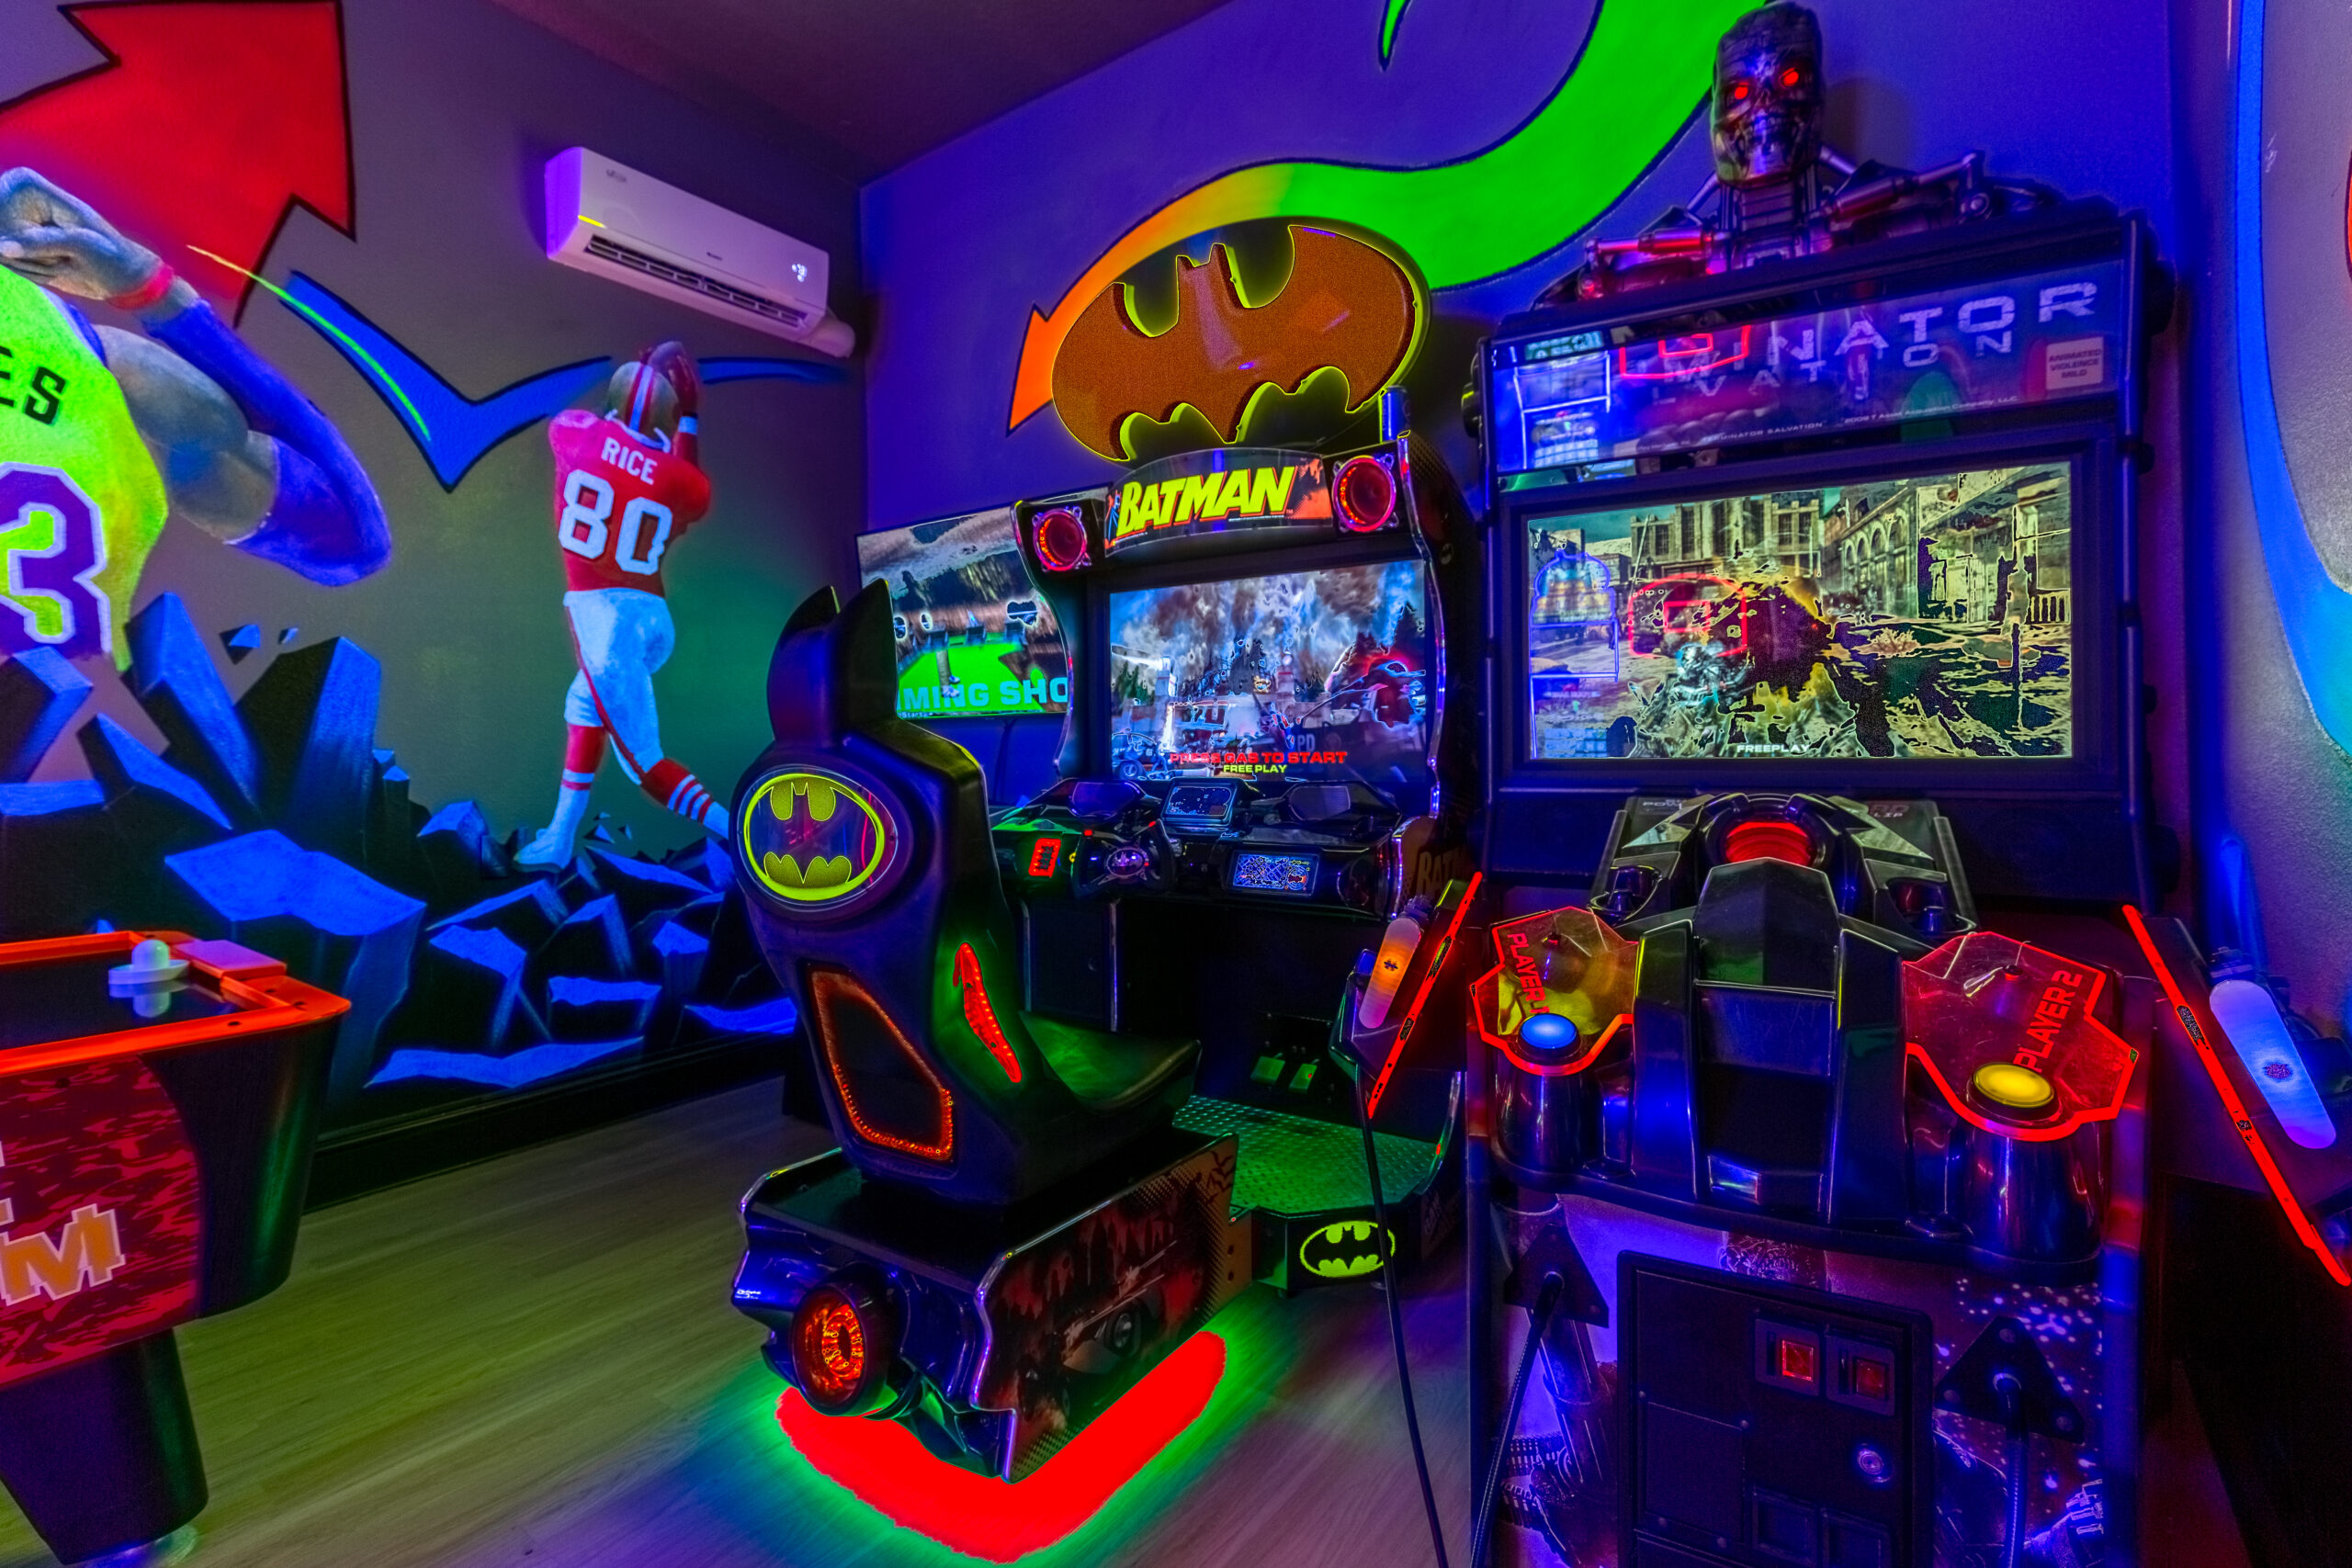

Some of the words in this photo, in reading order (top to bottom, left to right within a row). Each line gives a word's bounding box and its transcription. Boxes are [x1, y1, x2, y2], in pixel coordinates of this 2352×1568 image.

[2048, 348, 2102, 363] ANIMATED
[2050, 357, 2099, 371] VIOLENCE
[2061, 368, 2087, 378] MILD
[601, 436, 658, 485] RICE
[1115, 466, 1297, 538] BATMAN
[558, 468, 673, 576] 80
[999, 677, 1068, 705] SHO
[1170, 752, 1222, 764] PRESS
[1224, 752, 1260, 763] GAS
[1261, 752, 1285, 763] TO
[1287, 751, 1347, 763] START
[1736, 744, 1810, 753] FREEPLAY
[1223, 764, 1253, 773] FREE
[1254, 764, 1287, 773] PLAY
[1507, 932, 1547, 1001] PLAYER
[1529, 1006, 1551, 1014] 1
[2012, 987, 2076, 1074] PLAYER
[2051, 970, 2084, 988] 2
